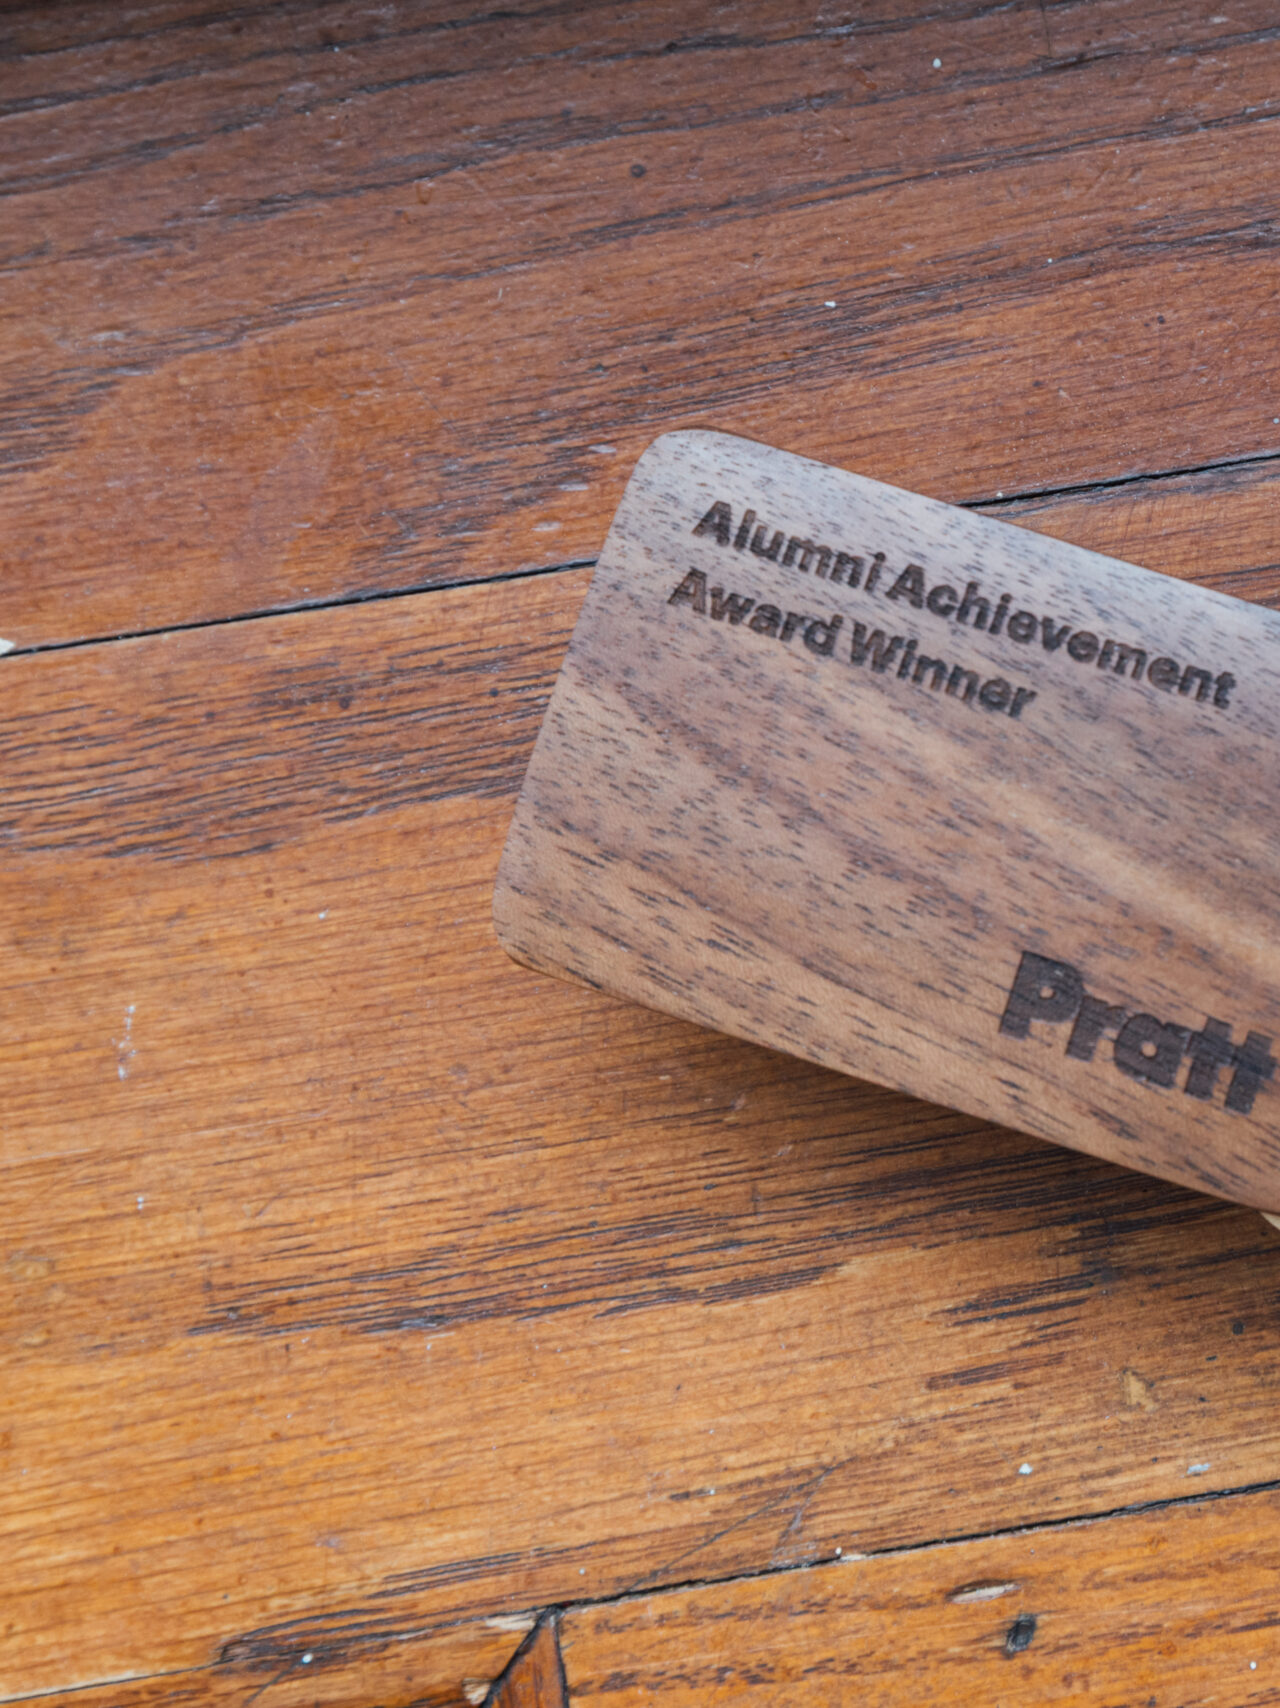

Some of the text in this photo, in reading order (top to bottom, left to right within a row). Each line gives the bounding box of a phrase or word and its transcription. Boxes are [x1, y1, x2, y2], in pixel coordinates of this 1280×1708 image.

[667, 567, 1039, 718] Award Winner
[692, 500, 1238, 709] Alumni Achievement
[999, 950, 1278, 1115] Pratt
